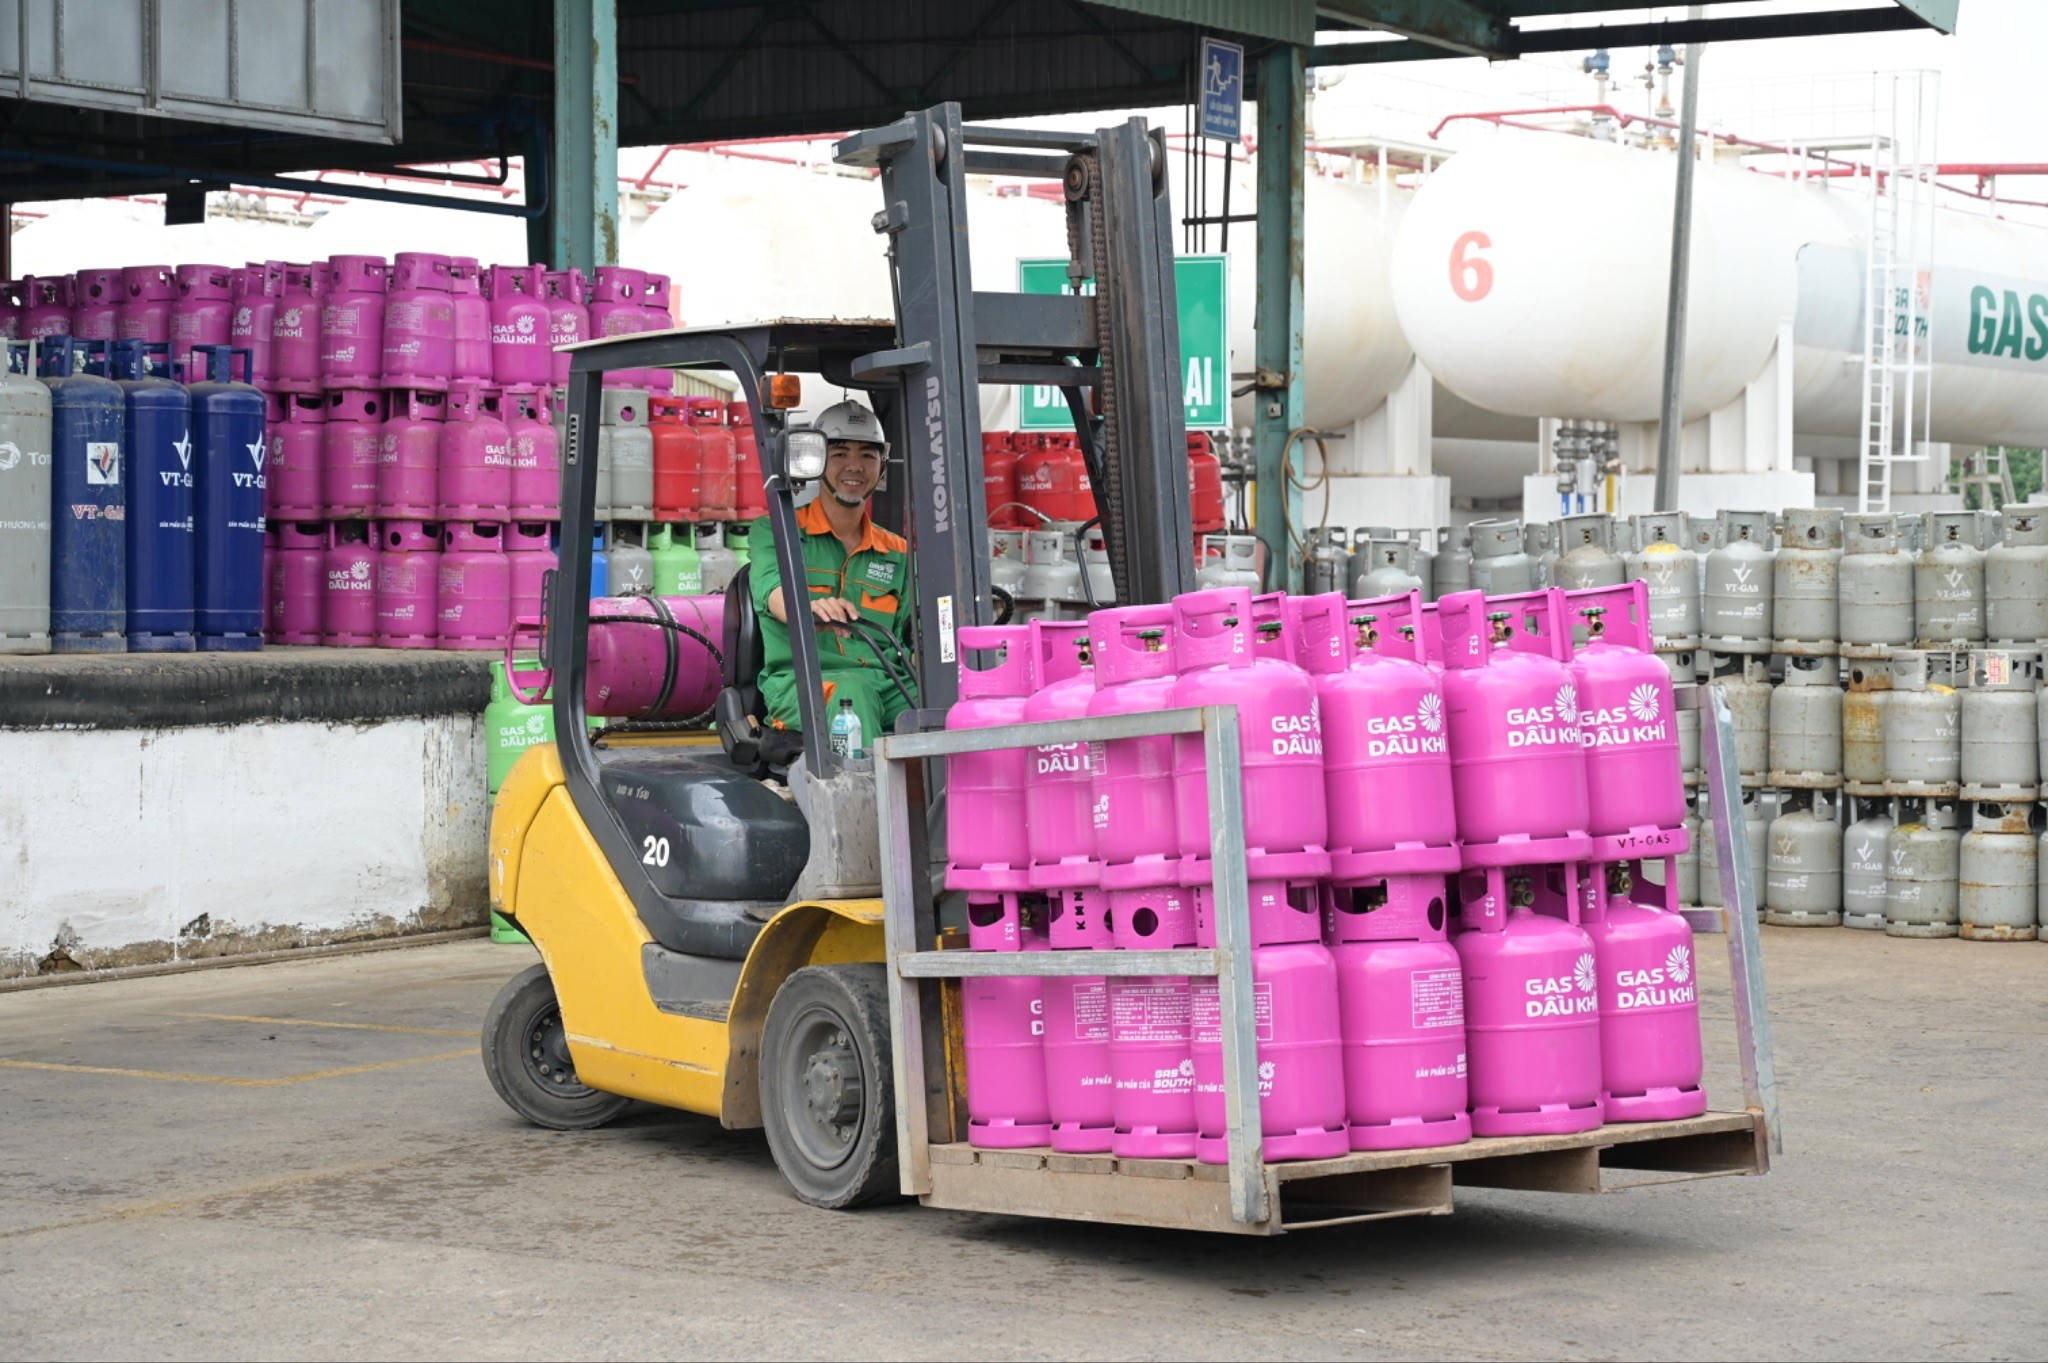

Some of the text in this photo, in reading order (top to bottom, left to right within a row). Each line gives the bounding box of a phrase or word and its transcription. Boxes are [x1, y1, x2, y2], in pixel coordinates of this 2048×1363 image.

[1450, 231, 1493, 302] 6
[284, 326, 302, 338] KHÍ
[493, 324, 515, 334] GAS
[1968, 285, 2048, 362] GAS
[493, 332, 536, 344] DẦU KHÍ
[560, 334, 579, 344] KHÍ
[1184, 357, 1212, 417] ẠI
[486, 445, 505, 454] GAS
[925, 376, 948, 533] KOMATSU
[518, 456, 537, 467] KHÍ
[329, 570, 349, 579] GAS
[329, 579, 371, 590] DẦU KHÍ
[1233, 632, 1244, 654] 13.5
[1330, 636, 1340, 657] 13.3
[1469, 634, 1478, 655] 13.2
[1272, 716, 1311, 733] GAS
[1367, 716, 1416, 734] GAS
[1507, 707, 1554, 725] GAS
[1580, 706, 1627, 726] GAS
[500, 726, 525, 736] GAS
[500, 733, 547, 747] DẦU KHÍ
[1508, 725, 1555, 747] DẦU
[1582, 720, 1665, 747] DẦU KHÍ
[1272, 734, 1312, 755] DẦU
[1368, 732, 1446, 756] DẦU KHÍ
[1038, 753, 1078, 774] DẦU
[1618, 834, 1670, 848] VT-GAS
[642, 835, 670, 867] 20
[1485, 896, 1495, 917] 13.3
[1005, 922, 1014, 941] 13.1
[1525, 976, 1572, 995] GAS
[1616, 968, 1665, 986] GAS
[1618, 981, 1694, 1008] DẦU KHÍ
[1526, 992, 1598, 1017] DẦU KHÍ
[1154, 1078, 1192, 1088] SOUTH
[1155, 1069, 1178, 1078] GAS
